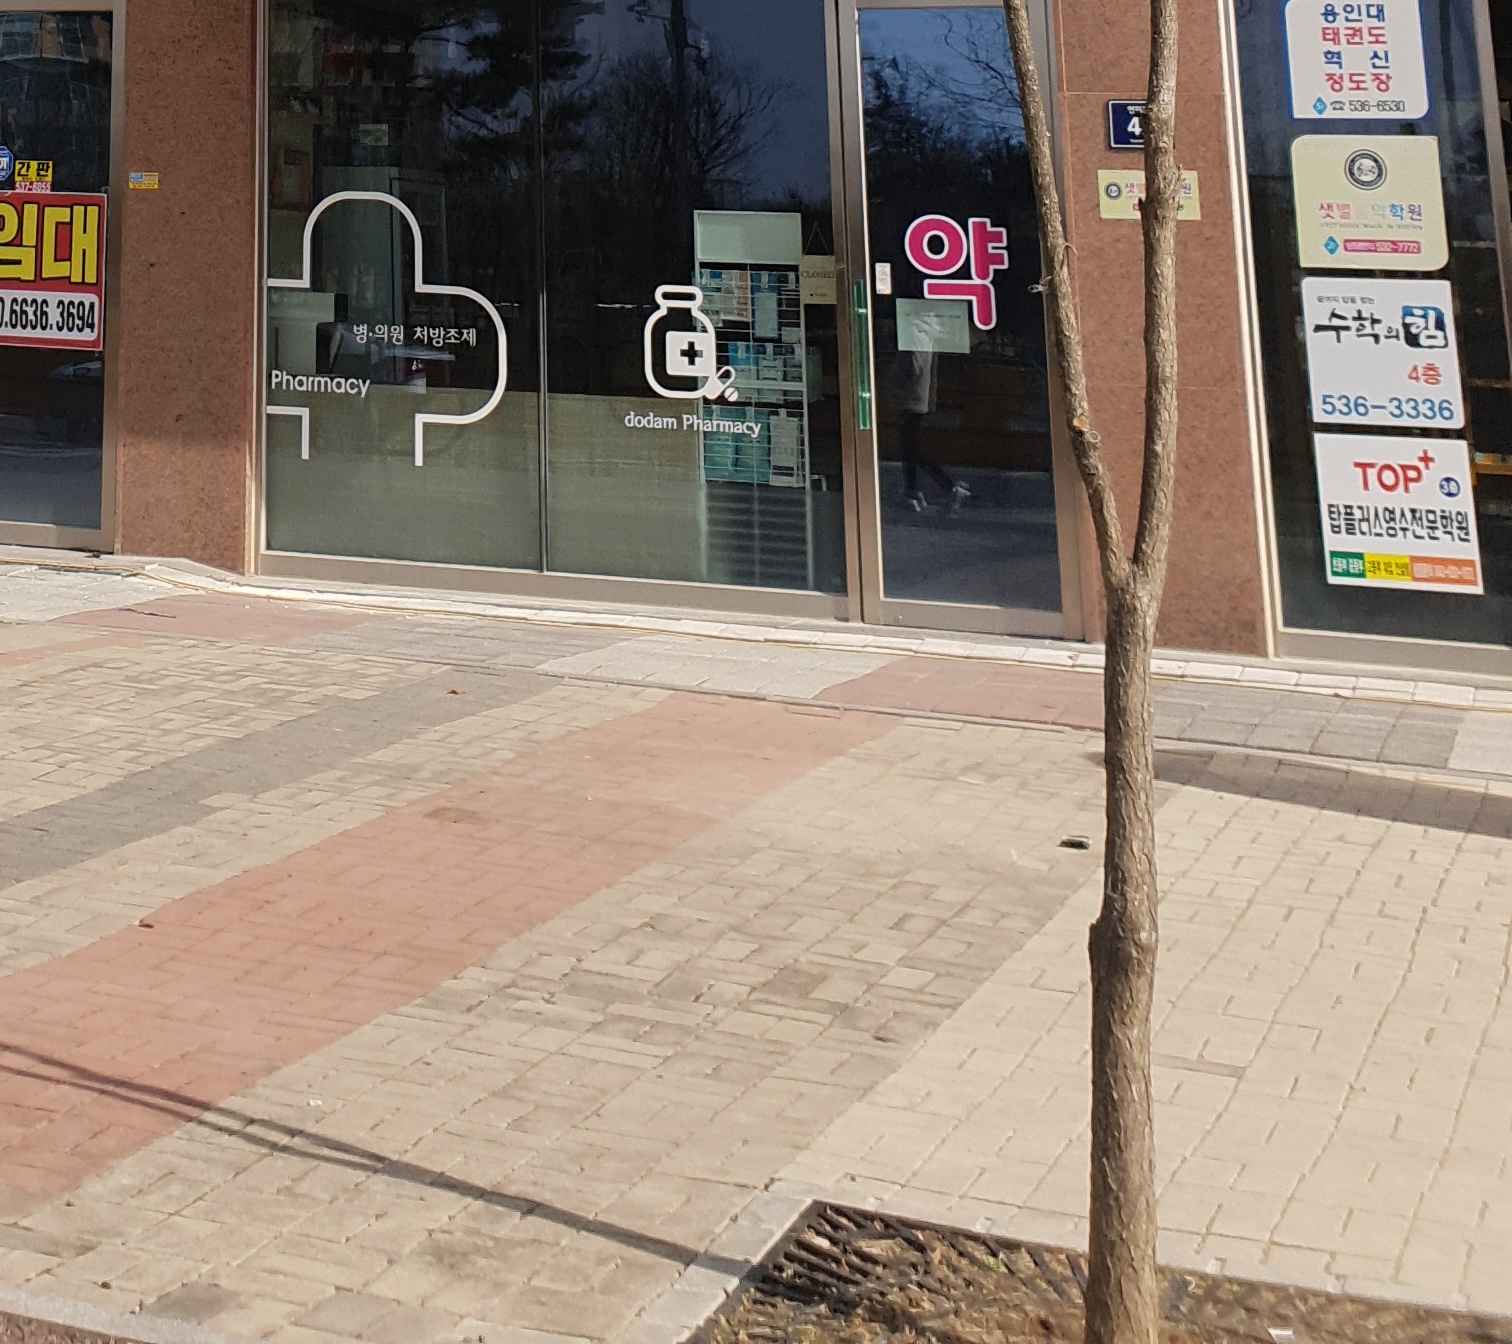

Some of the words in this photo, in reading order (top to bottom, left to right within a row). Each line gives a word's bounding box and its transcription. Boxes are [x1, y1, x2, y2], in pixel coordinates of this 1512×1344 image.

[1320, 2, 1386, 24] 용인대
[1321, 25, 1388, 47] 태권도
[1324, 72, 1392, 94] 정도장
[1348, 99, 1405, 113] 536-6530
[904, 213, 1009, 331] 약
[412, 326, 478, 348] 처방조제
[1403, 308, 1447, 348] 힘
[270, 368, 372, 399] Pharmacy
[1407, 362, 1442, 385] 4층
[1320, 394, 1455, 421] 536-3336
[624, 410, 678, 431] dodam
[681, 414, 762, 439] Pharmacy
[1326, 502, 1472, 544] 탑플러스영수전문학원
